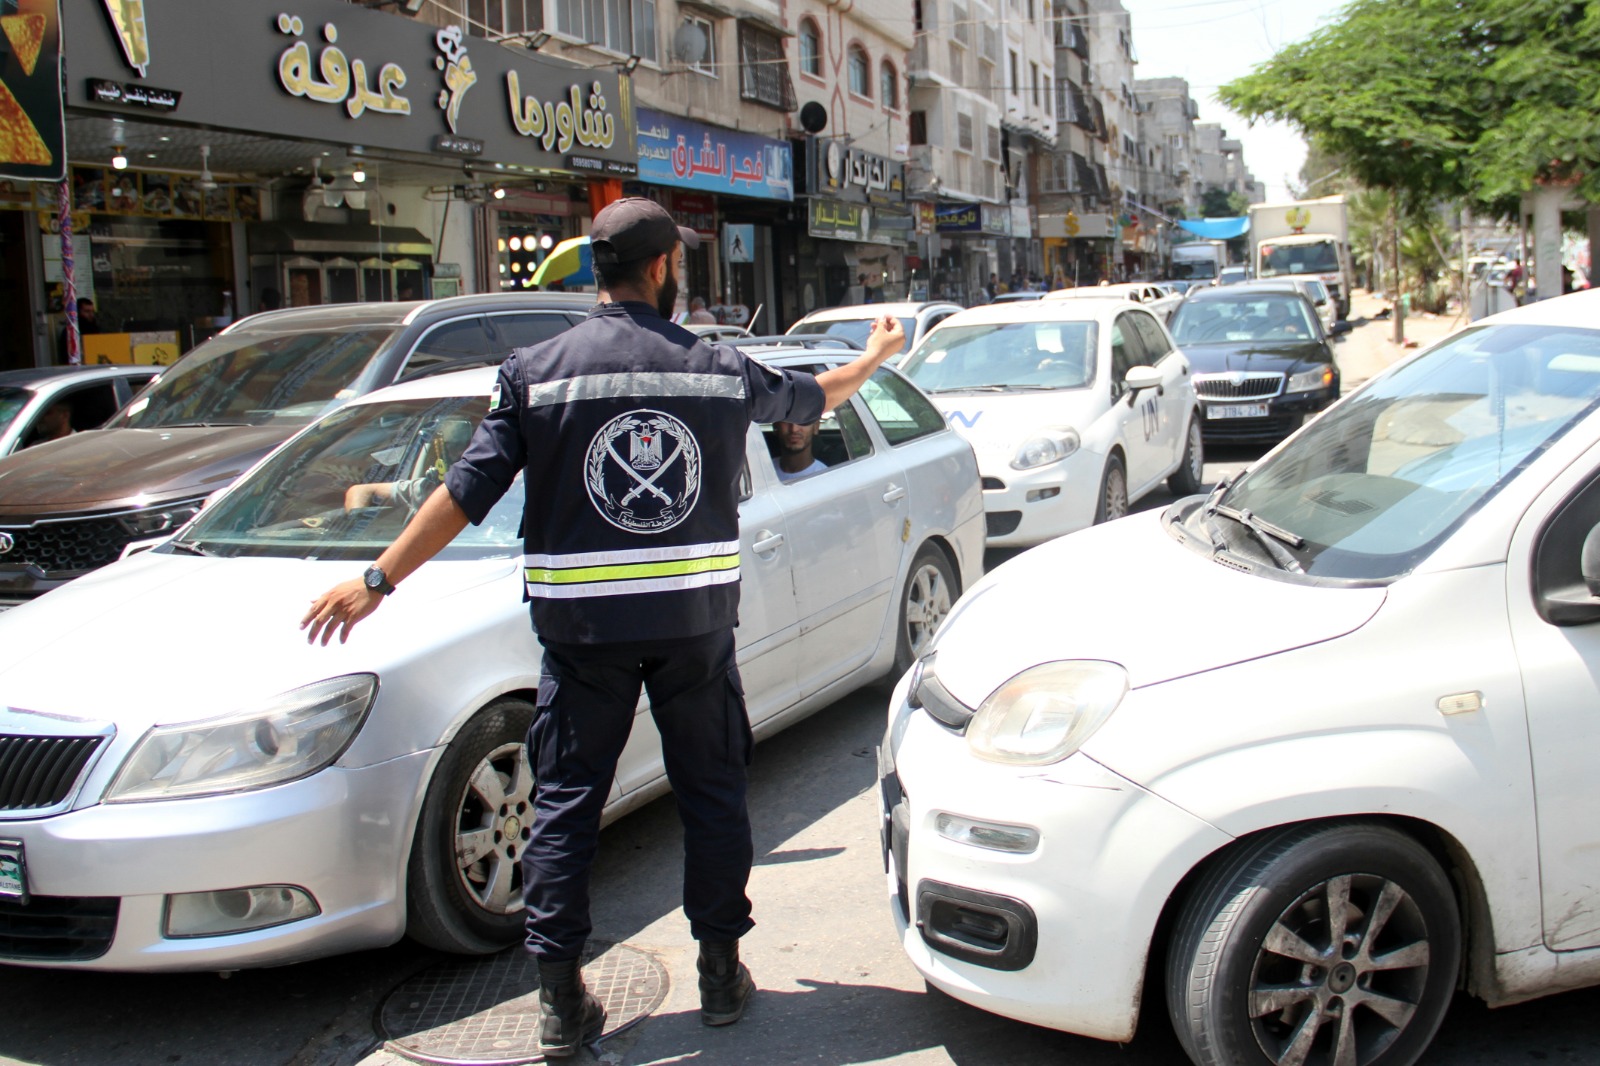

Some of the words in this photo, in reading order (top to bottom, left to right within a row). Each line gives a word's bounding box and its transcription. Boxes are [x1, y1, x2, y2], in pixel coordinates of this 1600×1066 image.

[277, 12, 411, 119] عرفة
[507, 69, 615, 153] شاورما
[671, 132, 728, 180] الشرق
[729, 151, 764, 188] فجر
[843, 149, 890, 195] الخزندار
[815, 201, 858, 228] الخزندار
[943, 410, 983, 428] N
[1141, 395, 1160, 442] UN
